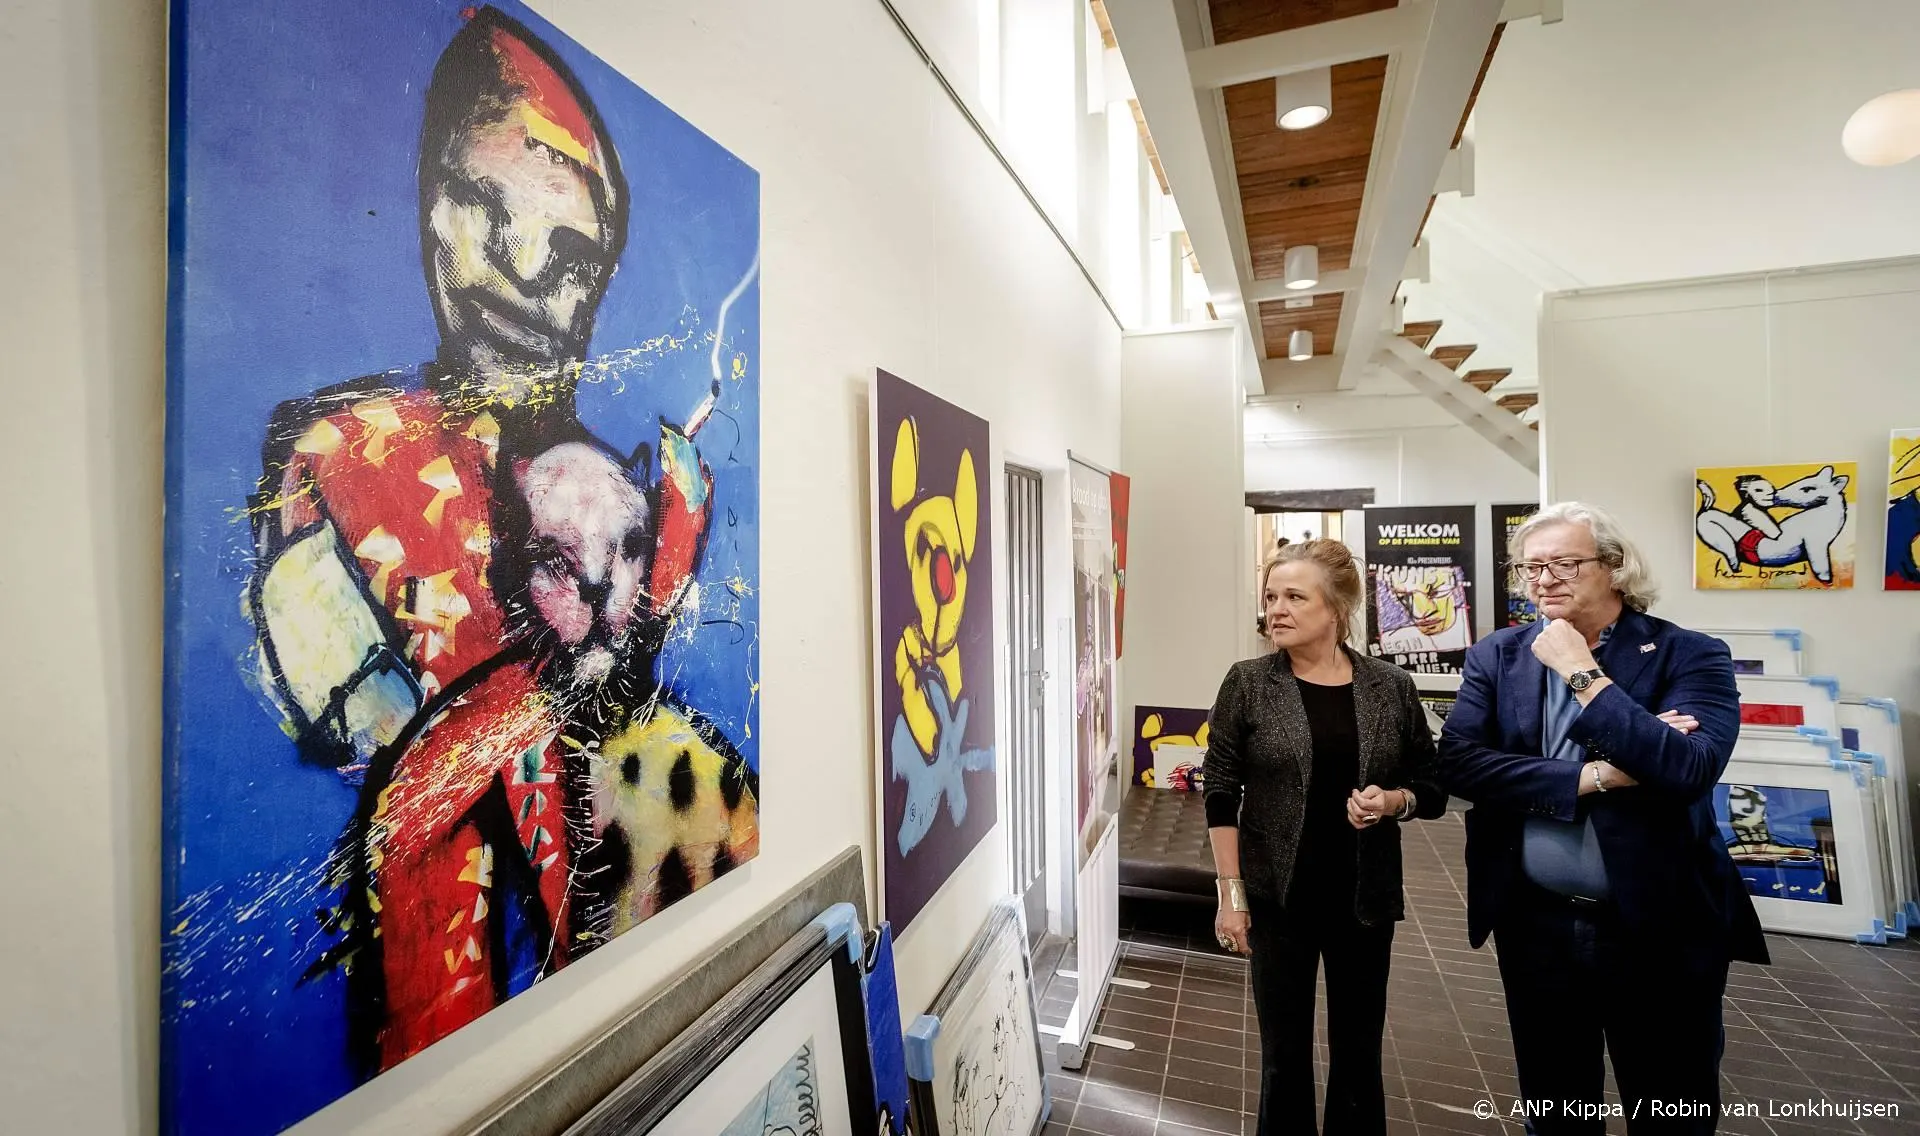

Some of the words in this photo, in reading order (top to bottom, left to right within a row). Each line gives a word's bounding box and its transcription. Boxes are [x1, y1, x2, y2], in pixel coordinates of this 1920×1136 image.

[1378, 524, 1460, 538] WELKOM
[1378, 538, 1391, 546] OP
[1416, 662, 1450, 674] NIET
